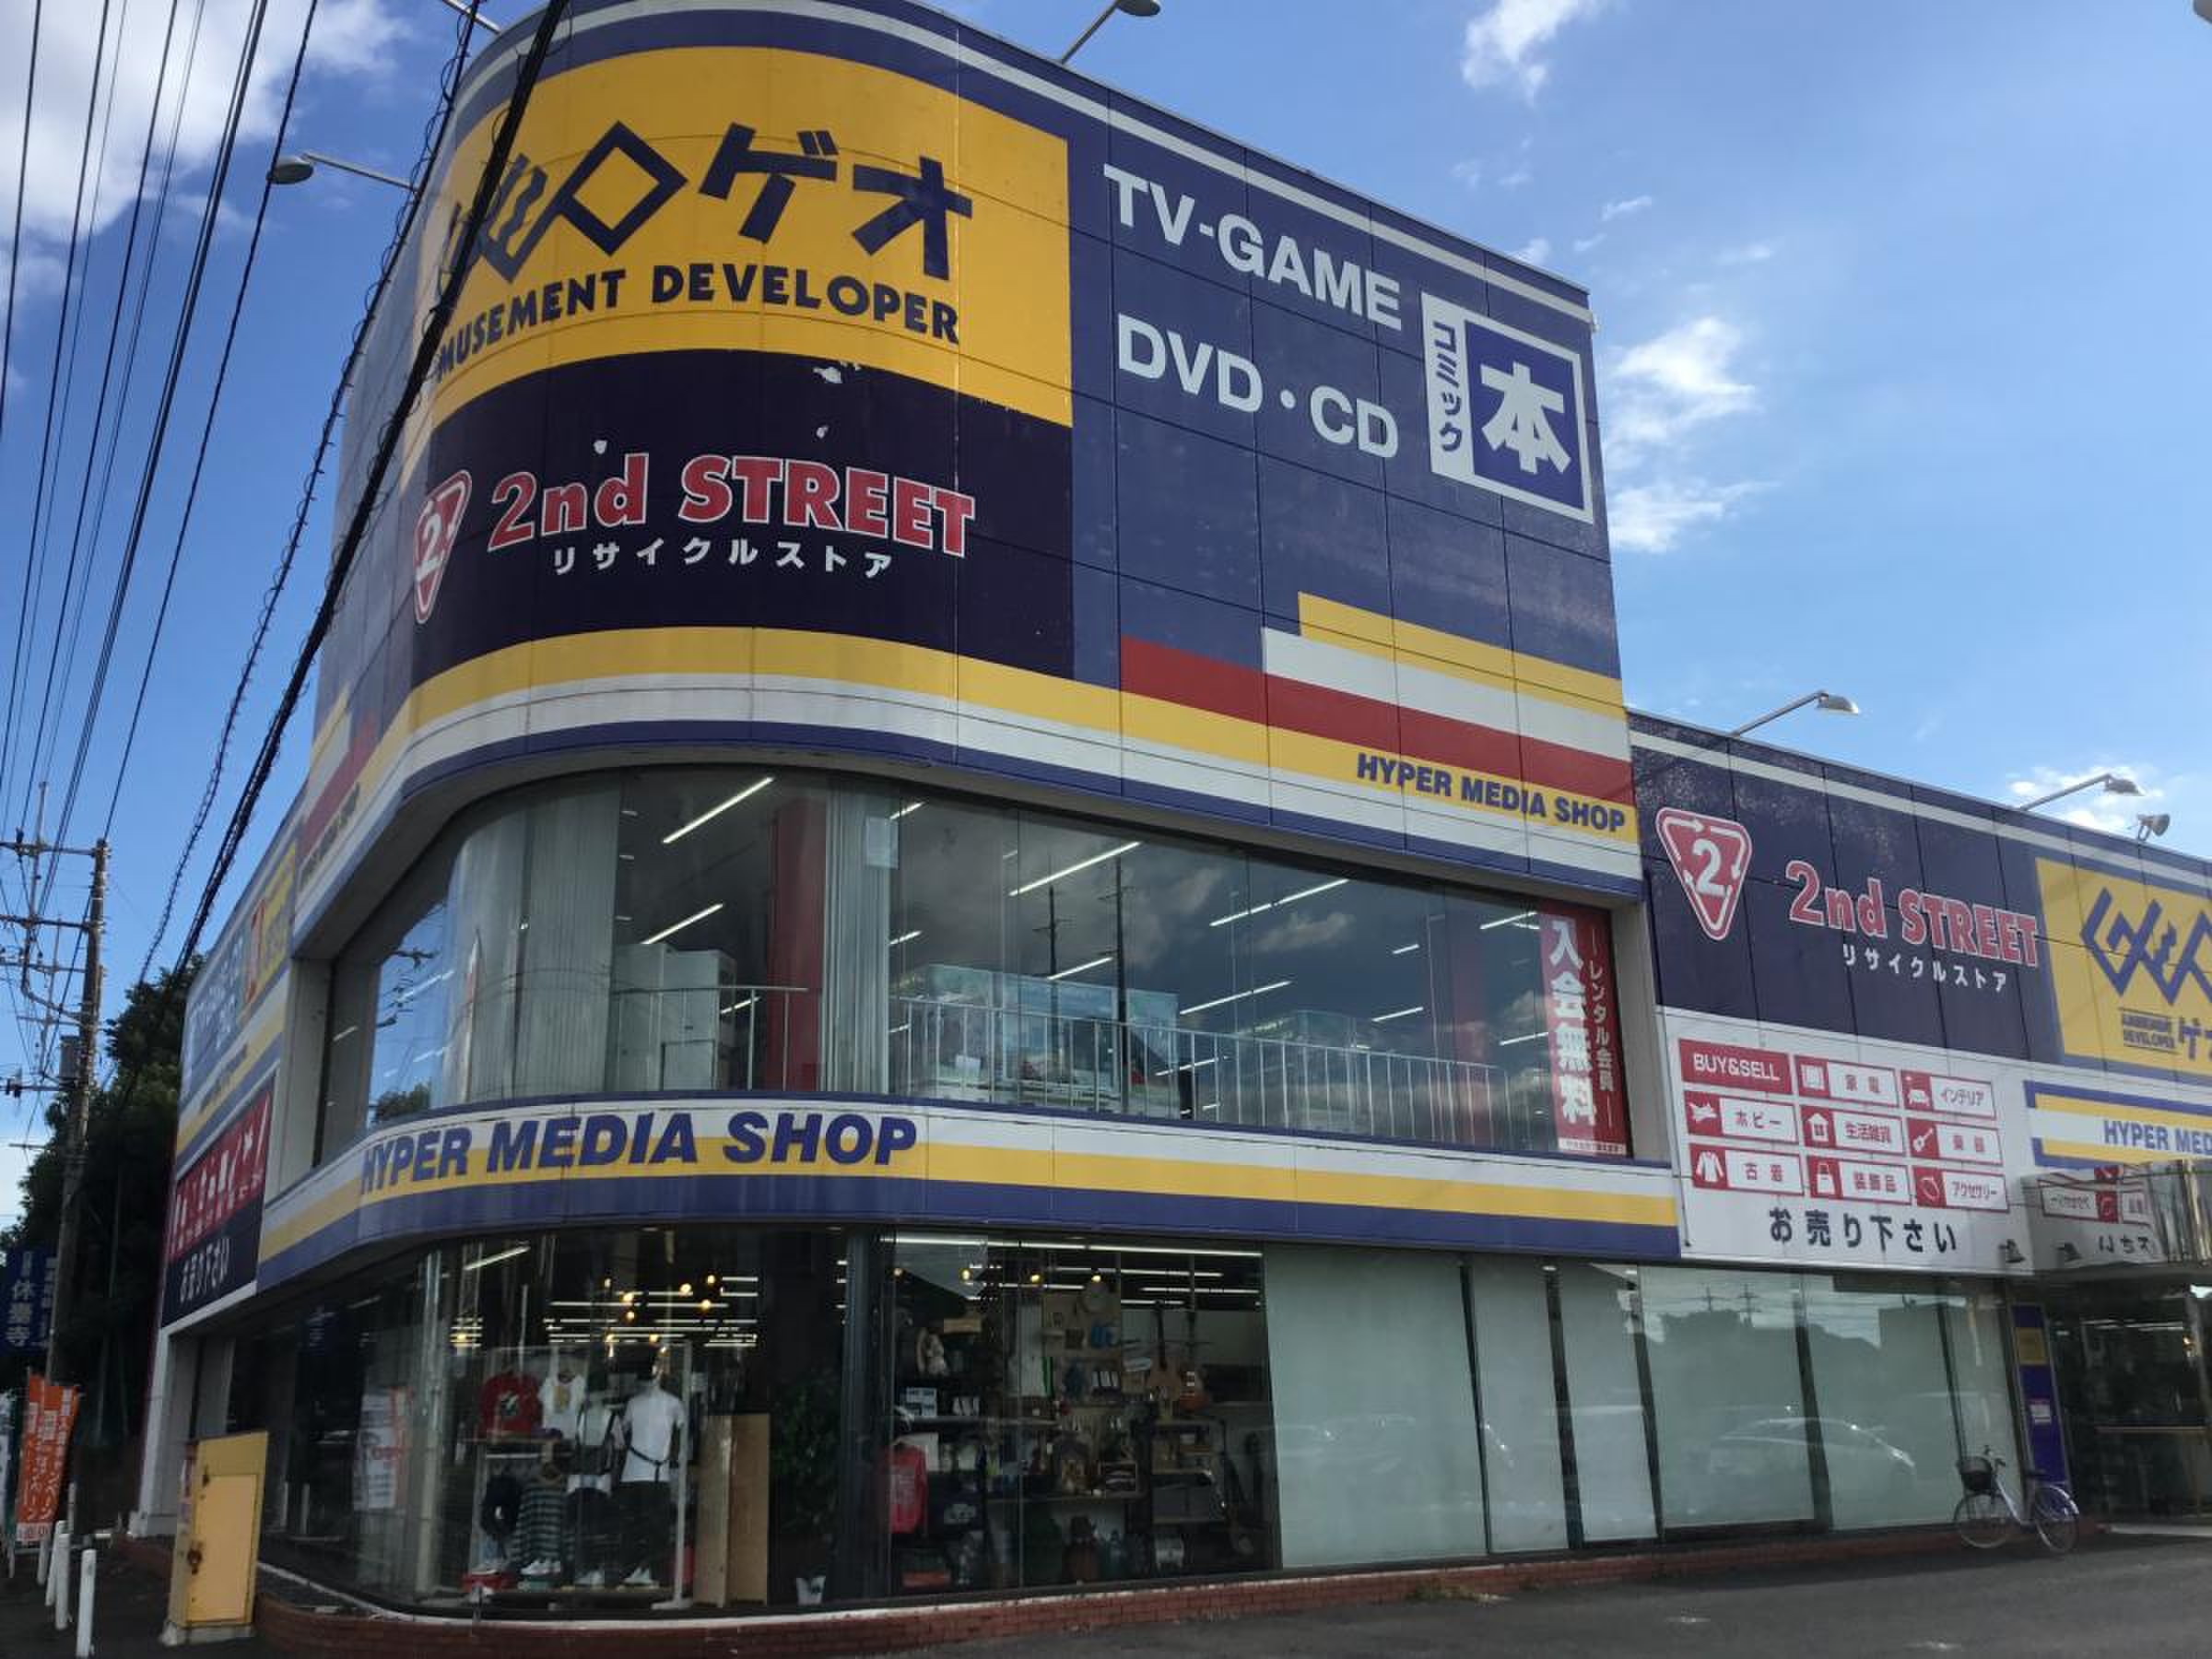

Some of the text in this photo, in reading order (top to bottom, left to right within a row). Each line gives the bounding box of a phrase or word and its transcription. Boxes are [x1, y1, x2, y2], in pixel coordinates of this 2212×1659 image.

[699, 122, 973, 281] ゲオ
[1103, 164, 1402, 332] TV-GAME
[652, 264, 960, 345] DEVELOPER
[1432, 321, 1463, 453] コミック
[1480, 361, 1571, 474] 本
[488, 453, 976, 559] 2nd STREET
[552, 536, 892, 579] リサイクルストア
[1357, 752, 1625, 832] HYPER MEDIA SHOP
[1785, 860, 2038, 967] 2nd STREET
[1842, 943, 2006, 993] リサイクルストア
[1549, 919, 1596, 1126] 入会無料
[1693, 1053, 1781, 1082] BUY&SELL
[1940, 1088, 1984, 1107] インテリア
[360, 1112, 917, 1195] HYPER MEDIA SHOP
[1735, 1110, 1782, 1129] ホビー
[2103, 1120, 2169, 1151] HYPER
[1769, 1206, 1958, 1253] お売り下さい
